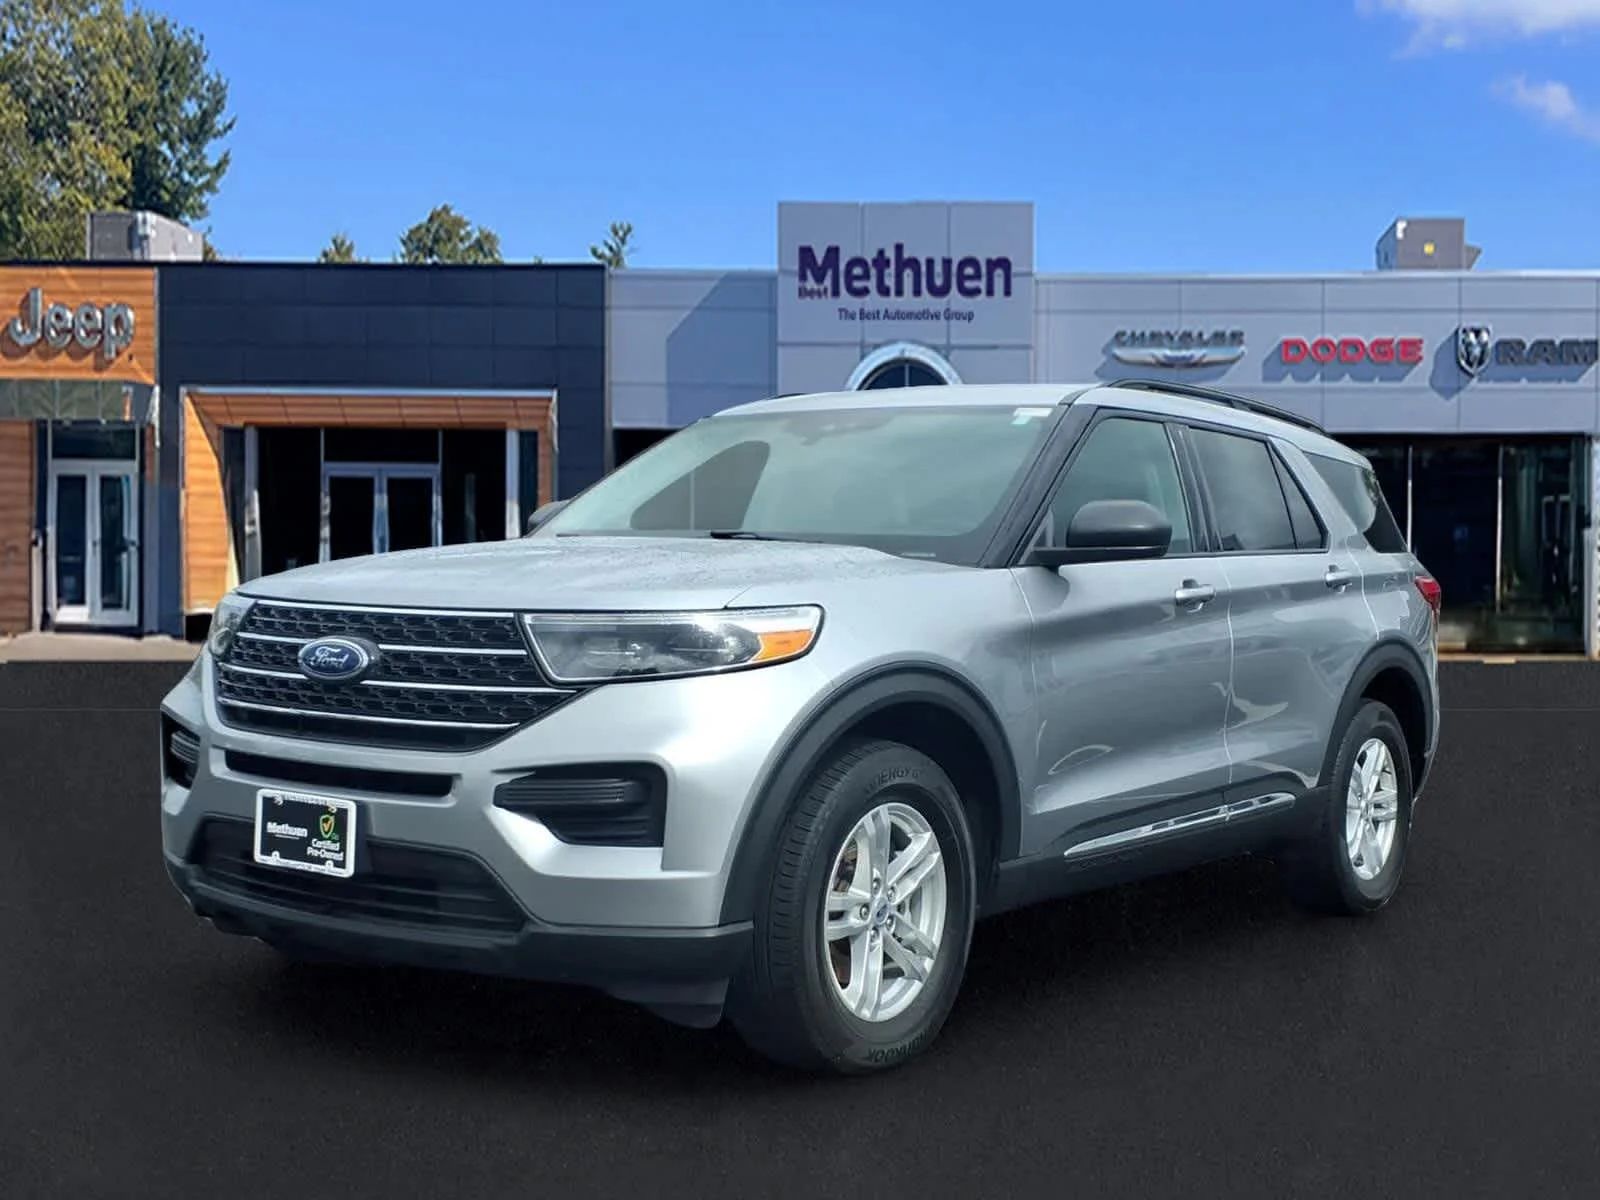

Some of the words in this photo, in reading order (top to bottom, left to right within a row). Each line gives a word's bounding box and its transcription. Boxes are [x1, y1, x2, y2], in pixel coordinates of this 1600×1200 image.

[798, 243, 1012, 298] Methuen
[798, 286, 828, 299] Best
[9, 287, 135, 360] Jeep
[838, 308, 855, 321] The
[859, 308, 880, 321] Best
[883, 308, 941, 321] Automotive
[943, 308, 975, 323] Group
[1280, 337, 1425, 363] DODGE
[1495, 339, 1599, 365] RAM
[308, 646, 350, 669] Ford
[266, 821, 308, 838] Methuen
